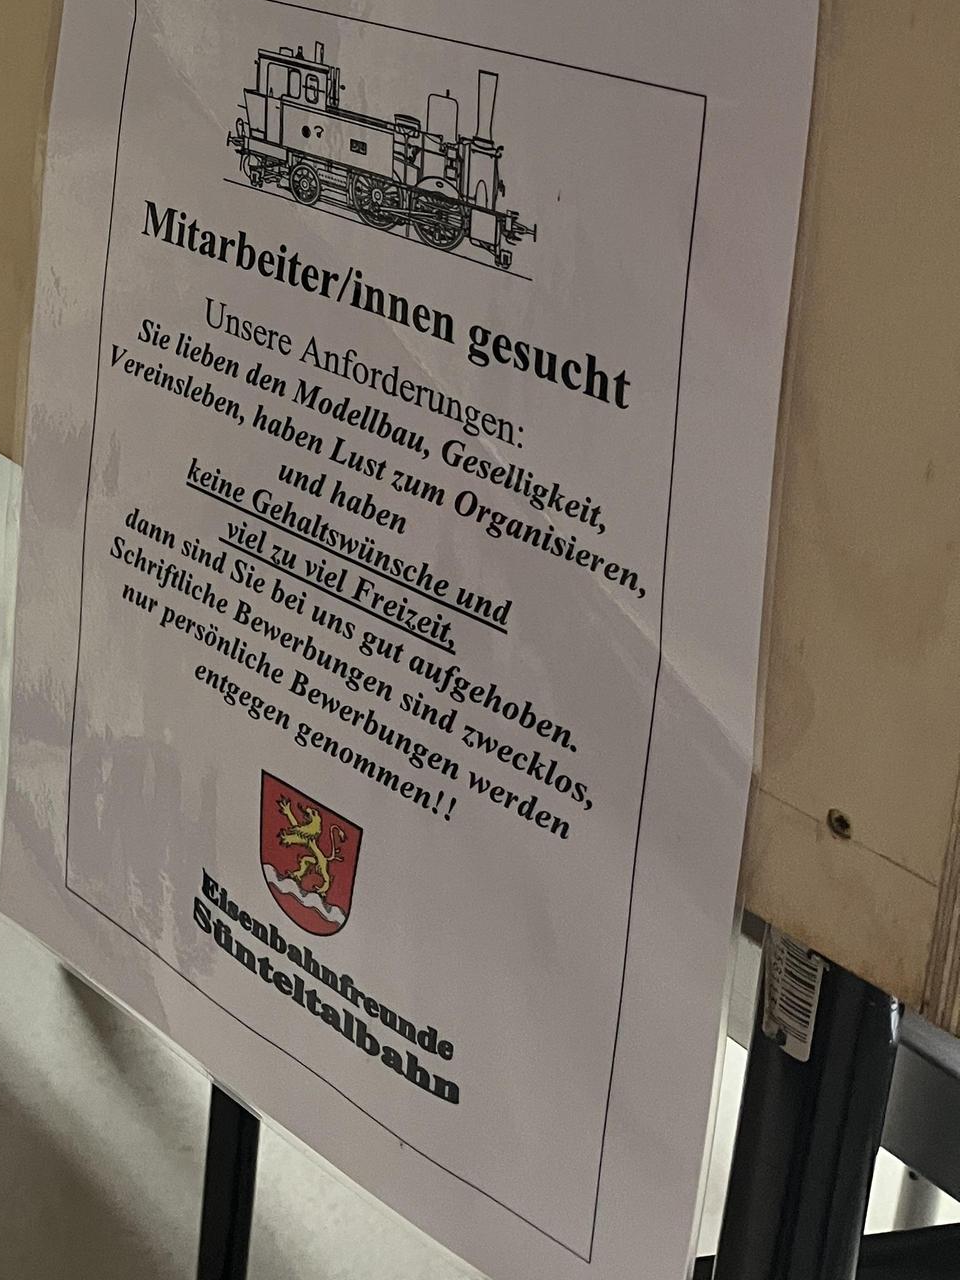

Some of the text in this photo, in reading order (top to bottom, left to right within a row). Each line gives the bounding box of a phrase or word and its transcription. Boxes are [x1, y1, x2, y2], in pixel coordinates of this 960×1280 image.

[141, 199, 632, 410] Mitarbeiter/innen gesucht
[205, 296, 525, 449] Unsere Anforderungen:
[109, 343, 647, 599] Vereinsleben, haben Lust zum Organisieren,
[138, 318, 606, 536] Sie lieben den Modellbau, Geselligkeit,
[278, 463, 407, 534] und haben
[125, 508, 578, 752] dann sind Sie bei uns gut aufgehoben.
[187, 458, 513, 627] keine Gehaltswünsche und
[226, 519, 456, 650] viel zu viel Freizeit,
[110, 536, 594, 811] Schriftliche Bewerbungen sind zwecklos,
[122, 583, 570, 840] nur persönliche Bewerbungen werden
[193, 662, 457, 821] entgegen genommen!!
[193, 896, 459, 1104] Sünteltalbahn
[202, 867, 454, 1060] Eisenbahnfreunde
